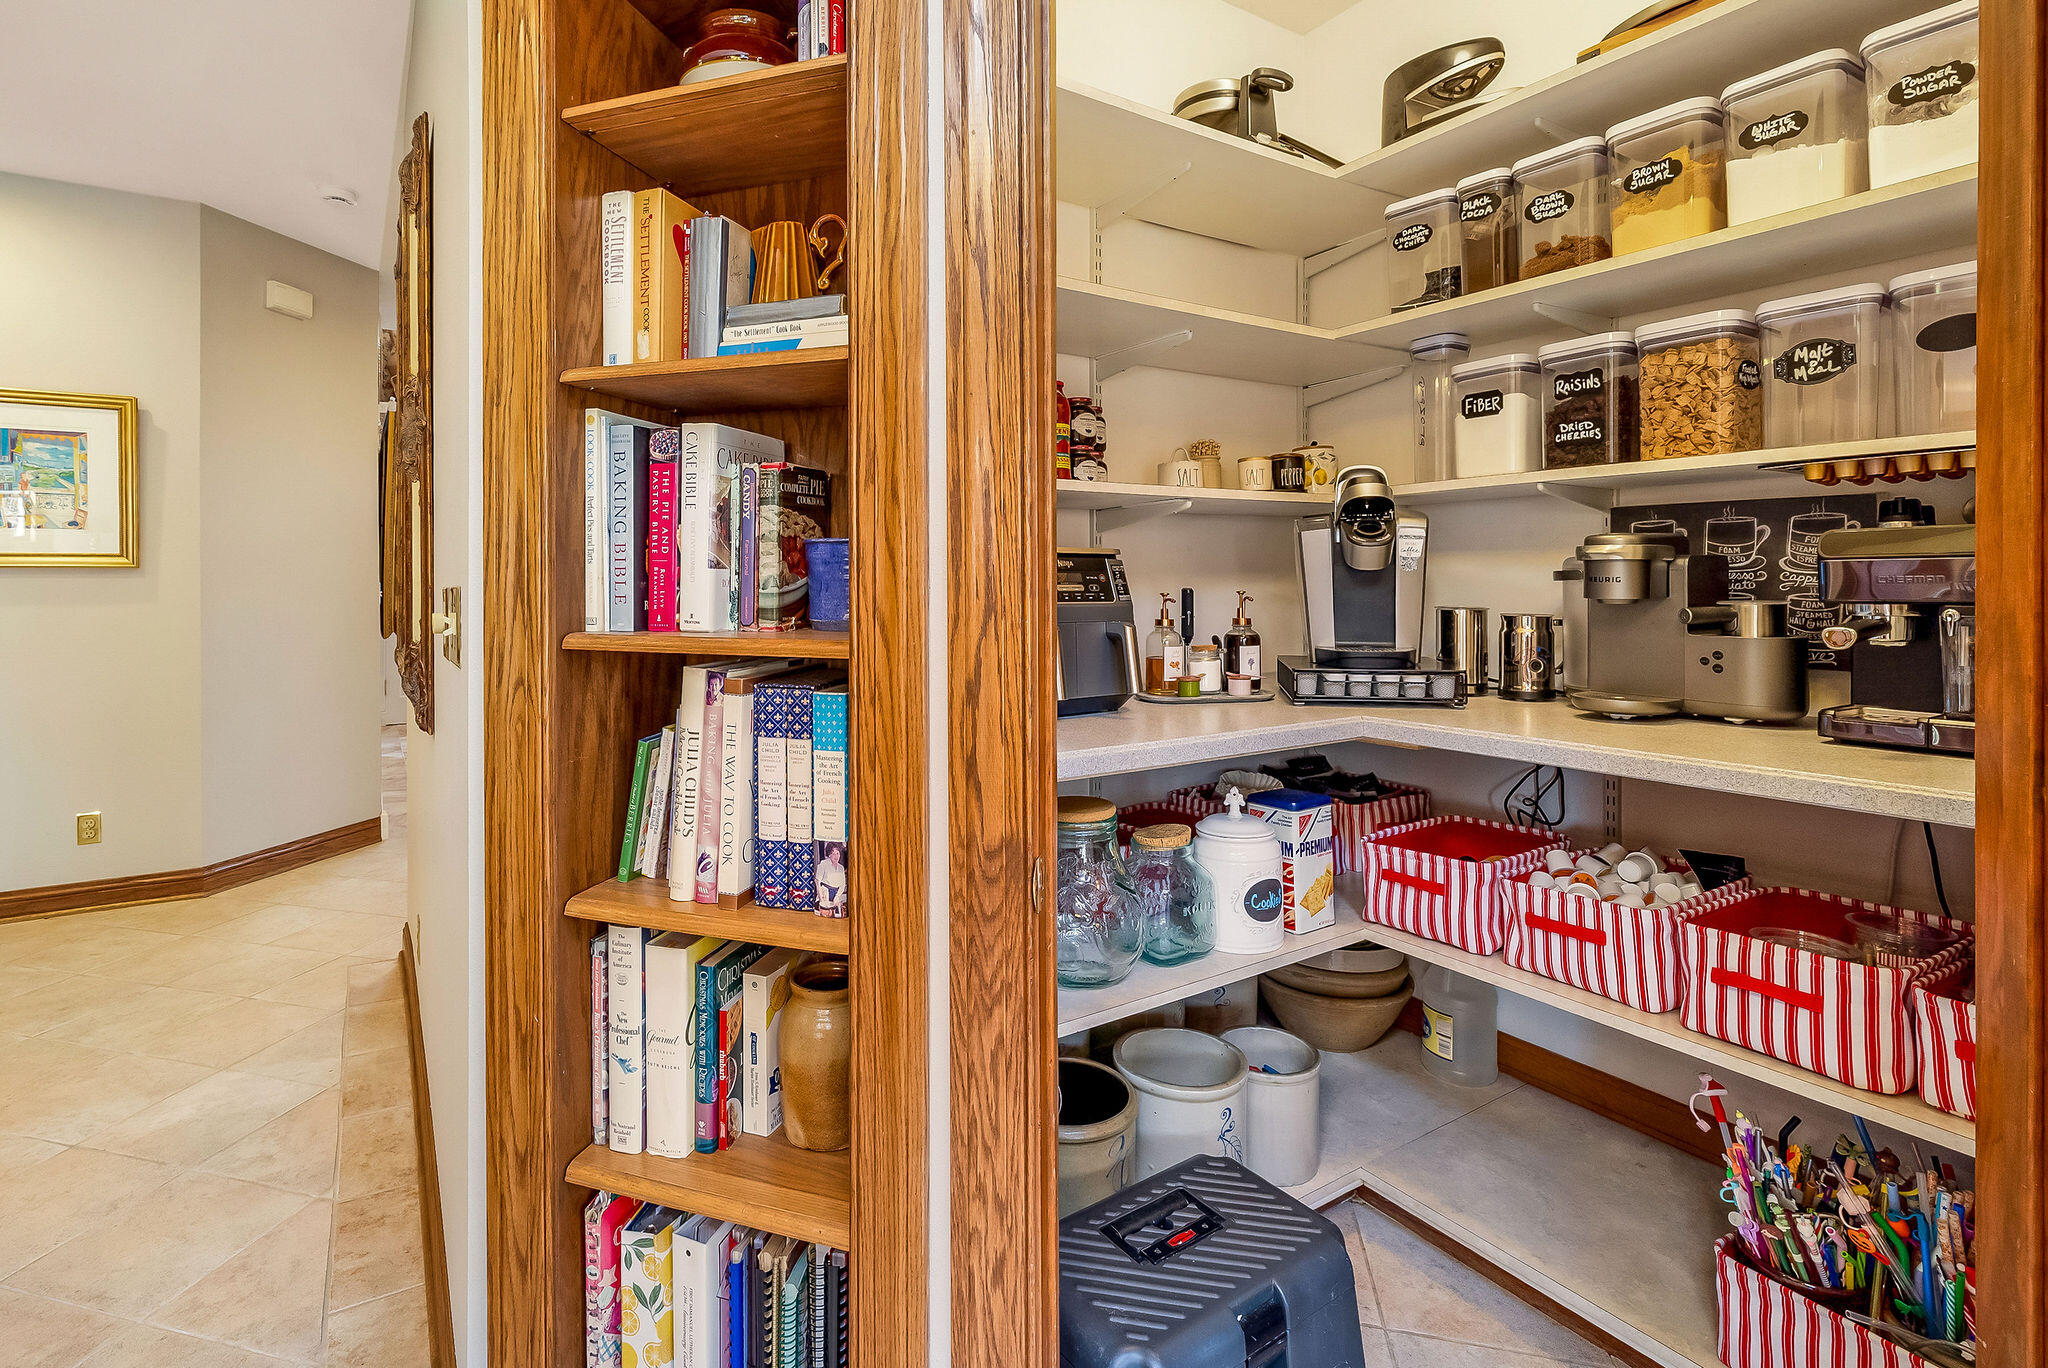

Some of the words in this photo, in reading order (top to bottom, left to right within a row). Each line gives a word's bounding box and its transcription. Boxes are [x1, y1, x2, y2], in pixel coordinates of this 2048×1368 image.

[1900, 64, 1957, 90] POWDER
[1902, 75, 1962, 99] SUGAR
[1752, 113, 1795, 136] WHITE
[1753, 119, 1801, 142] SUGAR
[1629, 168, 1674, 190] SUGAR
[1631, 159, 1670, 180] BROWN
[642, 197, 650, 214] THE
[1462, 195, 1491, 211] BLACK
[1530, 199, 1565, 215] BROWN
[1535, 192, 1564, 206] DARK
[1460, 205, 1494, 221] COCOA
[1534, 206, 1568, 220] SUGAR
[1394, 229, 1429, 245] CHOCOLATE
[1402, 225, 1426, 237] DARK
[610, 216, 627, 285] SETTLEMENT
[640, 217, 650, 306] SETTLEMENT
[642, 307, 650, 333] COOK
[775, 325, 788, 334] Cook
[789, 323, 802, 332] Book
[1793, 341, 1834, 363] Malt
[1793, 361, 1841, 381] Meal
[1555, 374, 1601, 396] RAISINS
[1465, 396, 1501, 414] FIBER
[1555, 428, 1601, 443] CHERRIES
[1559, 420, 1594, 433] DRIED
[586, 429, 595, 457] LOOK
[685, 431, 699, 468] CAKE
[743, 439, 761, 448] THE
[586, 462, 595, 491] COOK
[662, 470, 670, 494] THE
[1176, 467, 1199, 487] SALT
[1245, 468, 1265, 487] SALT
[1280, 467, 1304, 487] PEPPER
[613, 451, 627, 534] BAKING
[651, 470, 659, 514] PASTRY
[684, 472, 698, 510] BIBLE
[742, 474, 751, 520] CANDY
[780, 482, 808, 493] COMPLETE
[810, 479, 825, 496] PIE
[586, 495, 595, 517] Perfect
[796, 495, 825, 505] COOKBOOK
[662, 502, 670, 520] PIE
[586, 519, 595, 533] Pies
[587, 533, 595, 546] and
[651, 522, 659, 554] BIBLE
[661, 527, 669, 554] AND
[586, 547, 595, 564] Tarts
[1718, 546, 1741, 554] FOAM
[1791, 544, 1818, 553] STEAME
[1796, 555, 1818, 564] ESPRE
[613, 543, 627, 606] BIBLE
[1877, 574, 1946, 584] CHEFMAN
[1801, 600, 1825, 608] FOAM
[1789, 616, 1805, 625] HALF
[1816, 619, 1836, 627] HALF
[706, 714, 718, 764] BAKING
[725, 723, 737, 749] THE
[687, 728, 700, 772] JULIA
[815, 754, 843, 763] Mastering
[723, 756, 736, 792] WAY
[817, 777, 841, 786] Cooking
[674, 767, 684, 836] Cookbook
[682, 777, 697, 838] CHILD'S
[724, 796, 735, 816] TO
[624, 804, 636, 844] BERRIES
[701, 798, 713, 836] JULIA
[721, 821, 734, 866] COOK
[611, 940, 632, 948] Culinary
[611, 947, 632, 955] Institute
[612, 961, 632, 969] America
[698, 971, 708, 1010] CHRISTMAS
[615, 1013, 629, 1024] New
[609, 1022, 641, 1037] Professional
[646, 1030, 680, 1046] Gourmet
[698, 1012, 708, 1047] MEMORIES
[593, 1035, 601, 1071] Christmas
[698, 1050, 707, 1066] WITH
[719, 1050, 727, 1081] rhubarb
[698, 1067, 708, 1098] RECIPES
